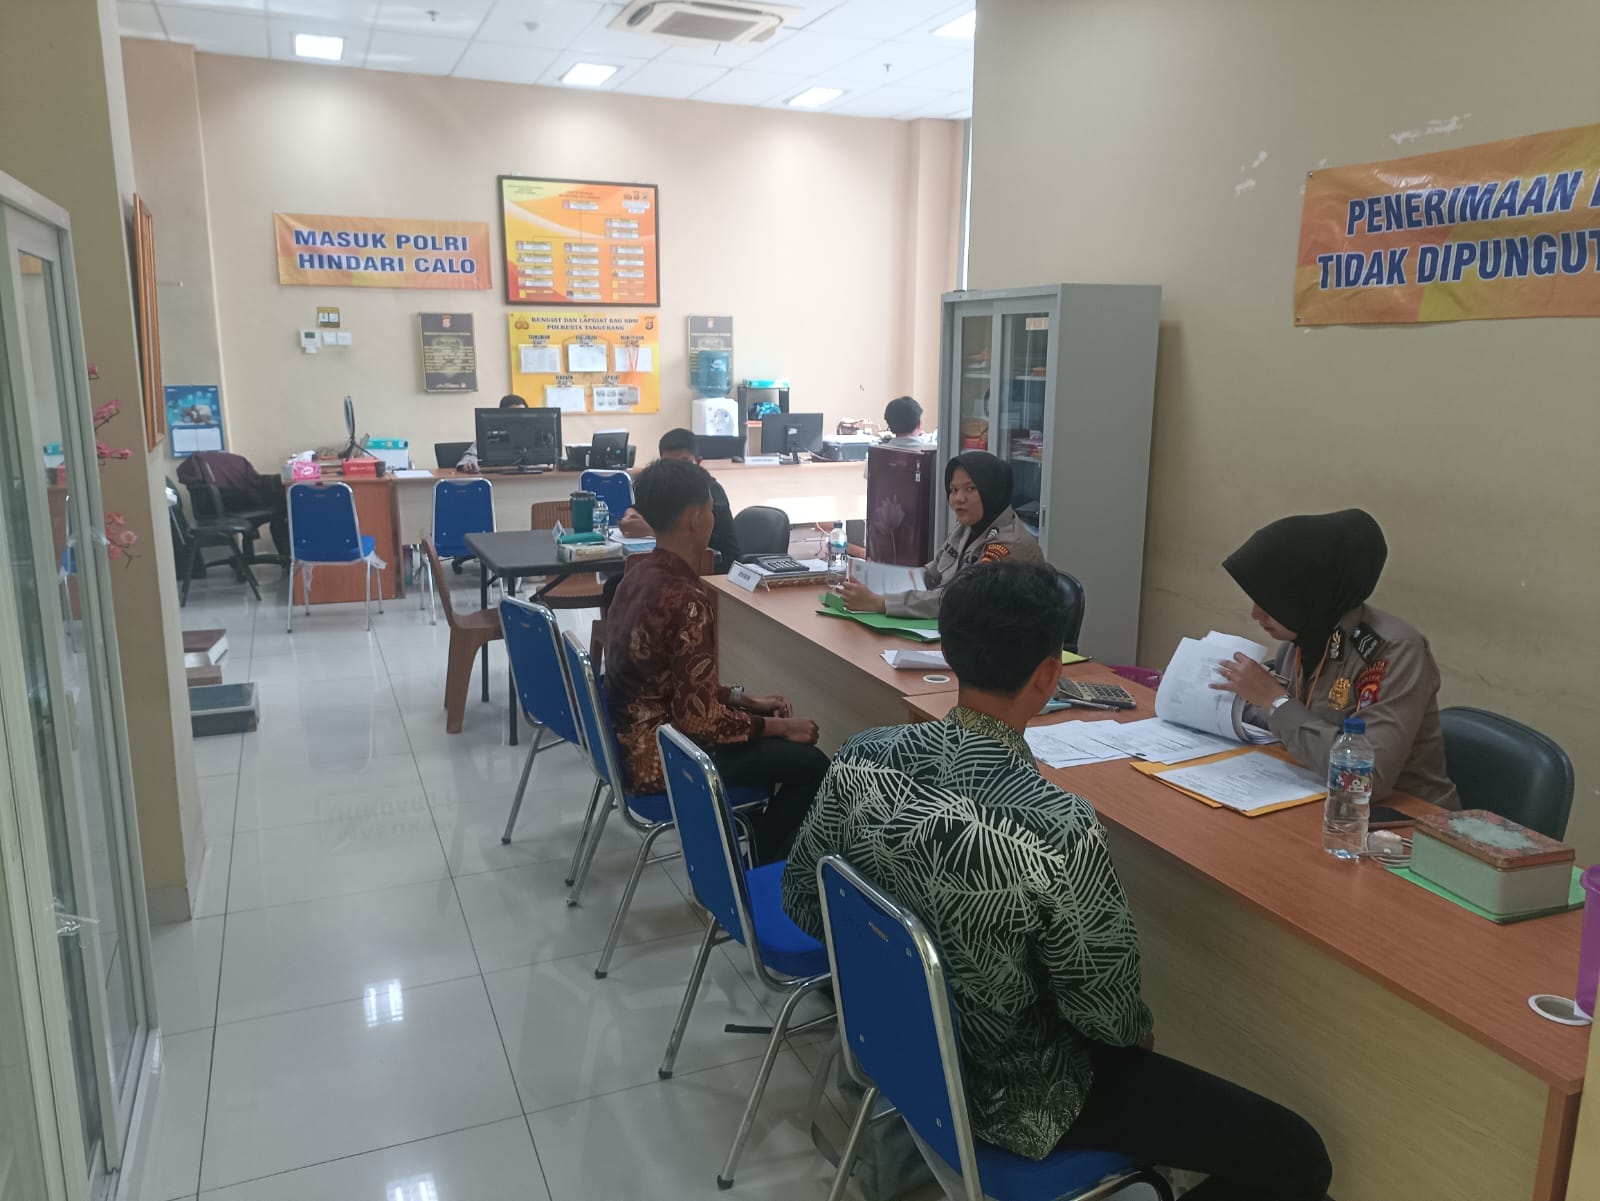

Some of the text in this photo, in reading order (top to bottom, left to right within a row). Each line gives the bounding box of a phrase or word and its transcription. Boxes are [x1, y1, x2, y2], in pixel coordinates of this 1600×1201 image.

[1346, 170, 1584, 236] PENERIMAAN
[294, 229, 468, 251] MASUK POLRI
[298, 254, 476, 274] HINDARI CALO
[1317, 247, 1409, 290] TIDAK
